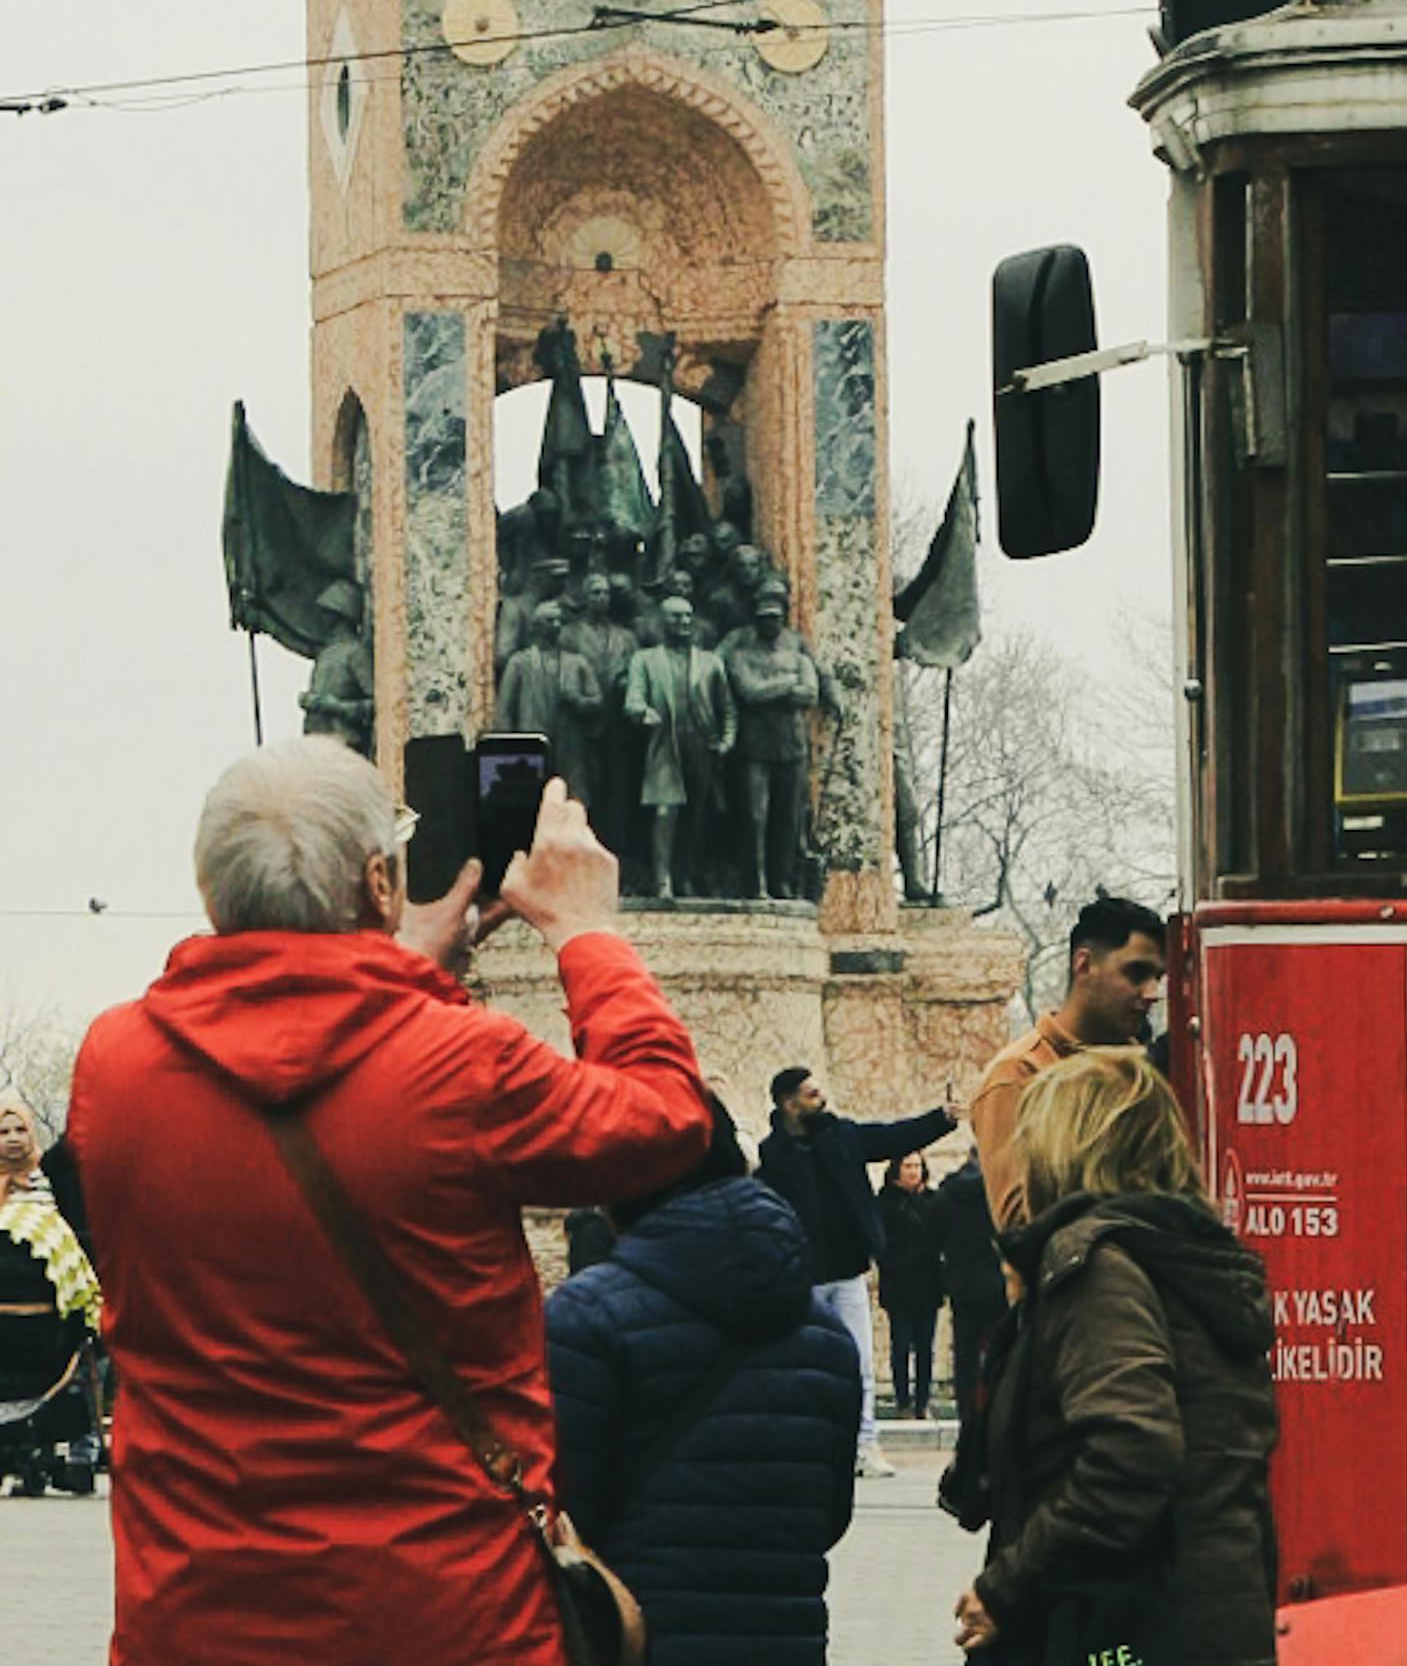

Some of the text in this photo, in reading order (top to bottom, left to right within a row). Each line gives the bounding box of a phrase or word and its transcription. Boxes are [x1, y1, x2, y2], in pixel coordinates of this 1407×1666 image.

[1237, 1033, 1297, 1124] 223
[1246, 1206, 1285, 1235] ALO
[1291, 1208, 1338, 1236] 153
[1293, 1290, 1376, 1325] YASAK
